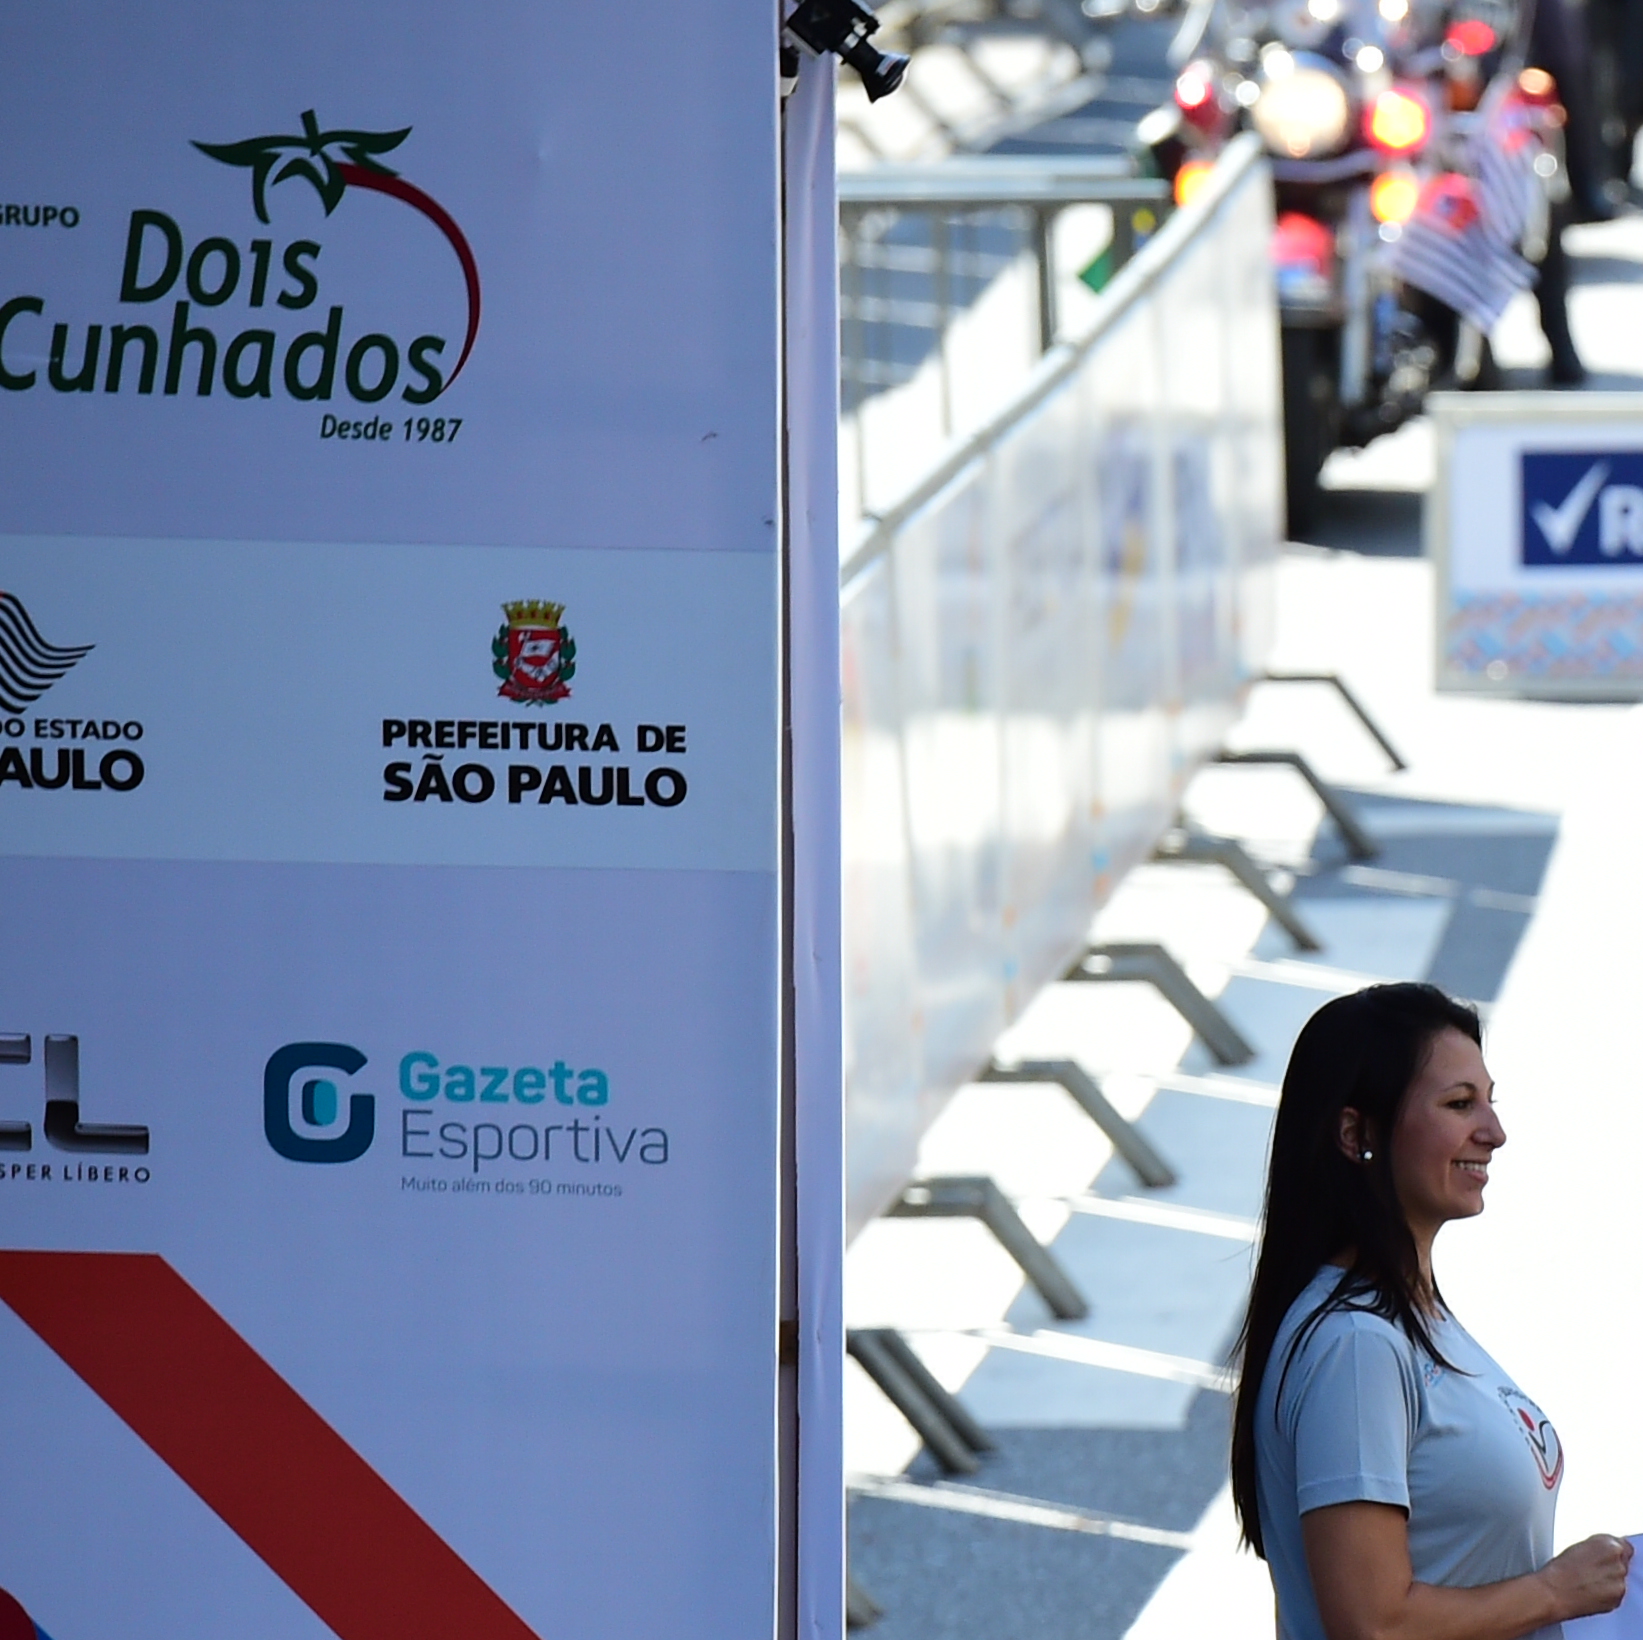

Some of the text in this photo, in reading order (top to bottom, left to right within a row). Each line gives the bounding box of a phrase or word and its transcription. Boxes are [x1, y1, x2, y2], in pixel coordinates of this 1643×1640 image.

[0, 203, 80, 228] RUPO
[118, 208, 322, 309] Dois
[0, 296, 446, 404] Cunhados
[320, 414, 463, 443] Desde 1987
[0, 718, 144, 741] O ESTADO
[382, 719, 686, 753] PREFEITURA DE
[383, 753, 688, 807] SÃO PAULO
[399, 1050, 610, 1107] Gazeta
[402, 1109, 669, 1173] Esportiva
[64, 1162, 150, 1183] LÍBERO
[401, 1176, 622, 1197] Muito além dos 90 minutos
